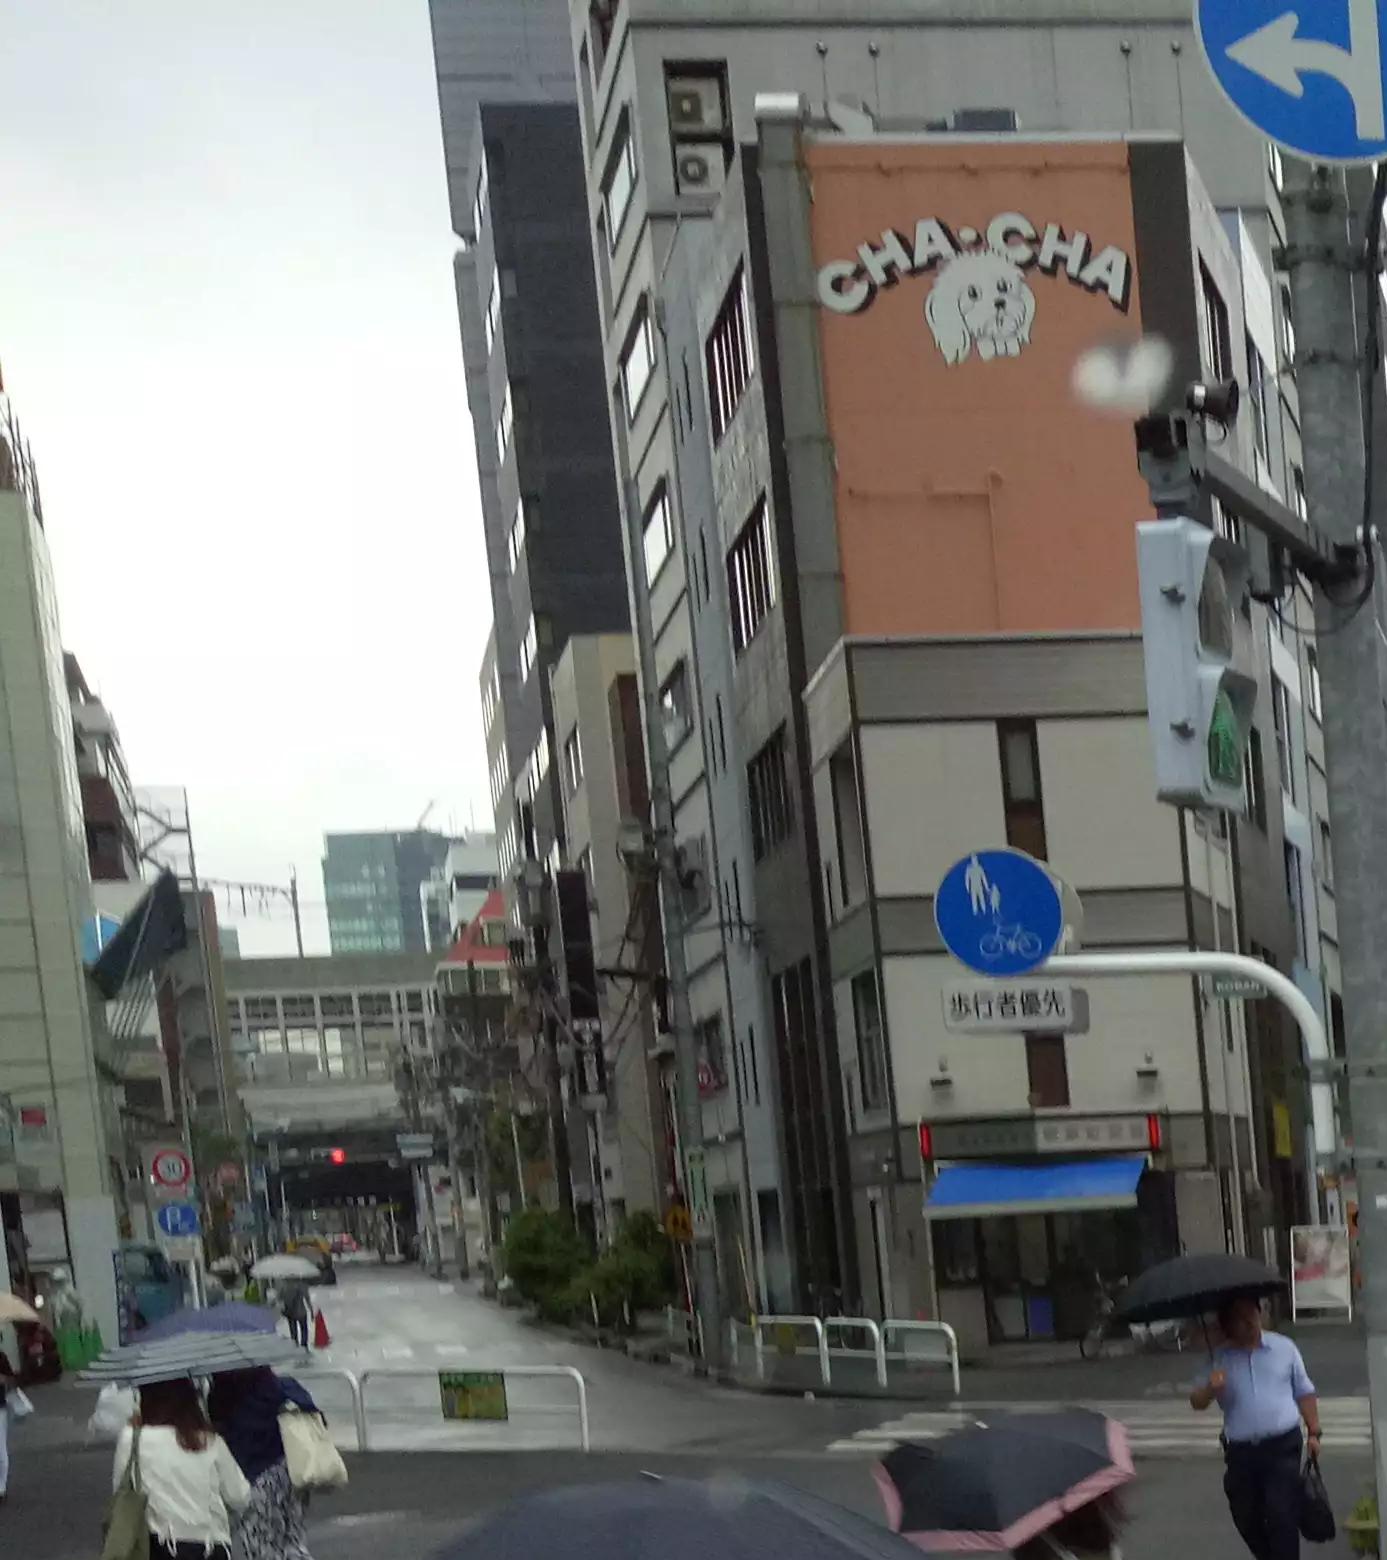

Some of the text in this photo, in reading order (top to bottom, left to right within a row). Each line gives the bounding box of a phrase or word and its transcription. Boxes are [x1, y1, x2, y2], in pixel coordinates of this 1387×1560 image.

[950, 985, 1067, 1020] 歩行者優先
